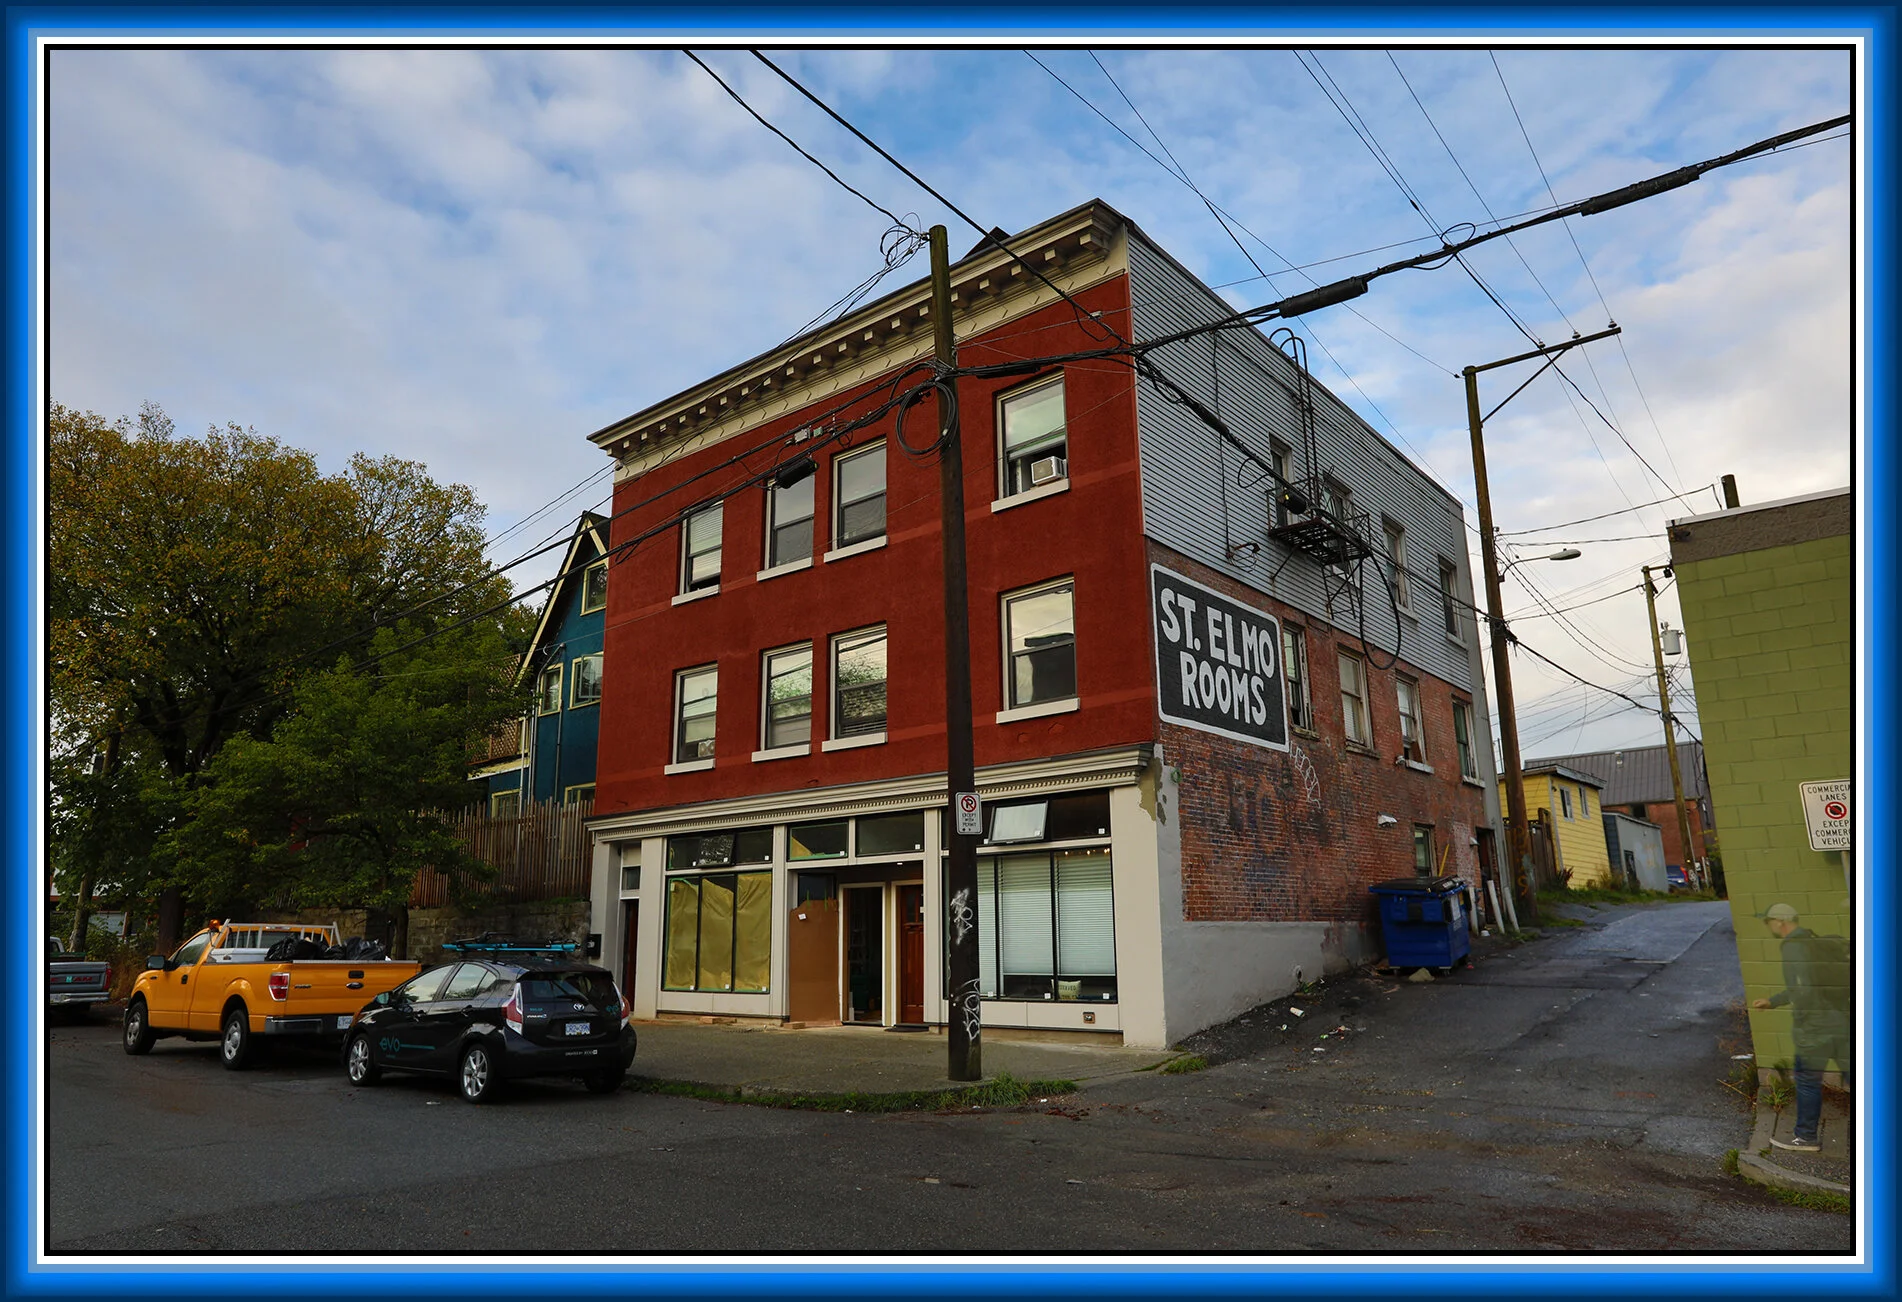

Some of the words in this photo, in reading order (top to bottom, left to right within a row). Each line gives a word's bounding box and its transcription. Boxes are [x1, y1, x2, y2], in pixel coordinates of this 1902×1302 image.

[1160, 587, 1201, 651] ST.
[1207, 606, 1275, 679] ELMO
[1180, 650, 1267, 726] ROOMS
[1820, 793, 1847, 802] LANES
[1815, 829, 1850, 838] COMMER
[379, 1036, 400, 1052] evo
